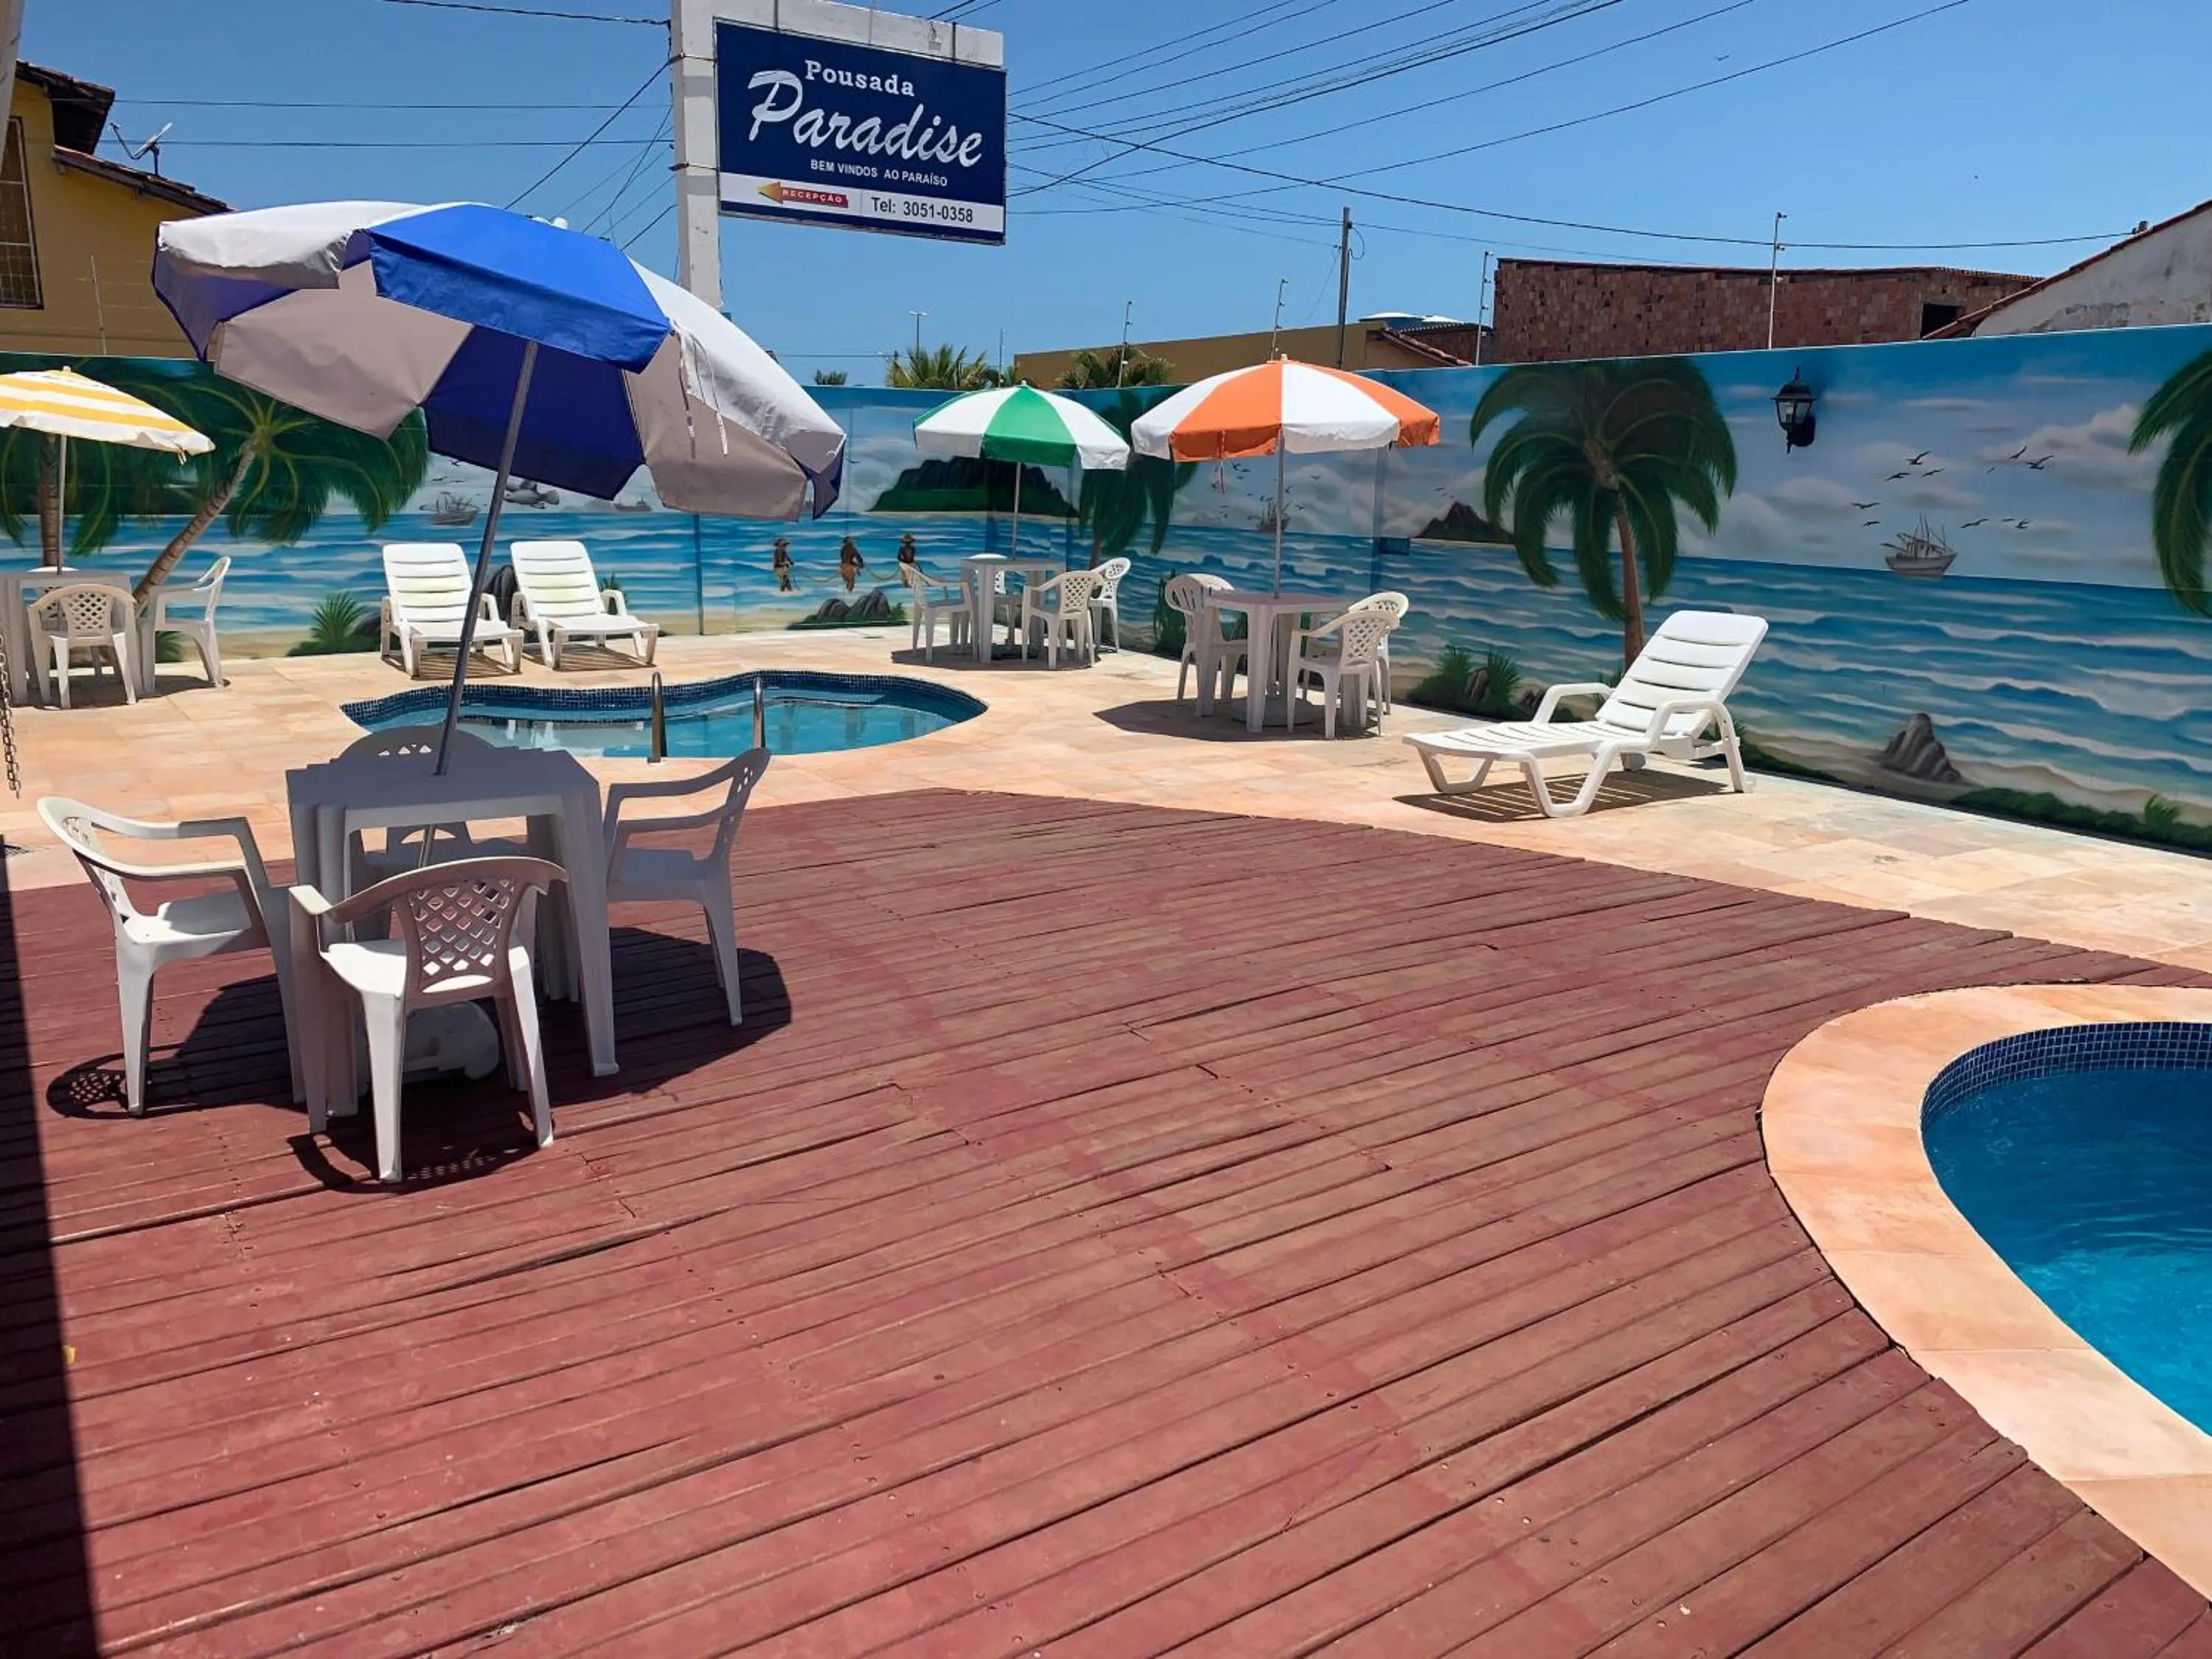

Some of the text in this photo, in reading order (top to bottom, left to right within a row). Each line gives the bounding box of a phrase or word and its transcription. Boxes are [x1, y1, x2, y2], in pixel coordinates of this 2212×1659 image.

[804, 60, 915, 97] Pousada
[748, 70, 983, 167] Paradise
[811, 159, 948, 187] BEM VINDOS AO PARAÍSO
[782, 188, 844, 204] RECEPÇÃO
[871, 197, 974, 223] Tel: 3051-0358
